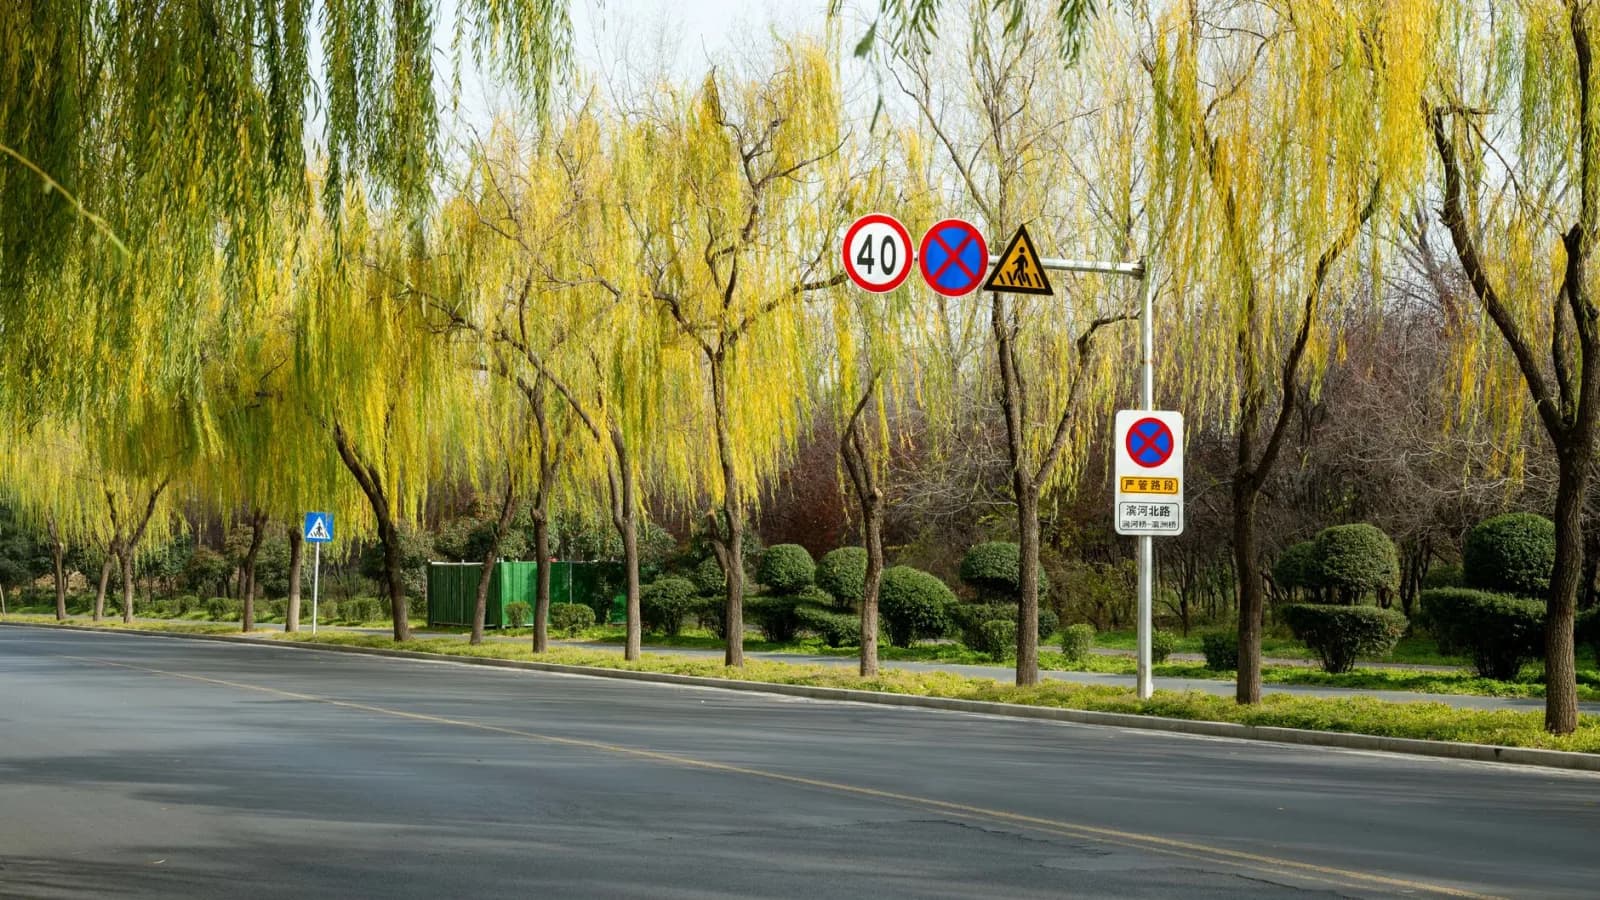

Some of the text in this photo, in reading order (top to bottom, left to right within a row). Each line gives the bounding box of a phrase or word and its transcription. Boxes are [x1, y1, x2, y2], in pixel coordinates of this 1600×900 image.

[857, 234, 896, 276] 40
[1125, 480, 1174, 491] 严管路段
[1126, 505, 1170, 517] 滨河北路
